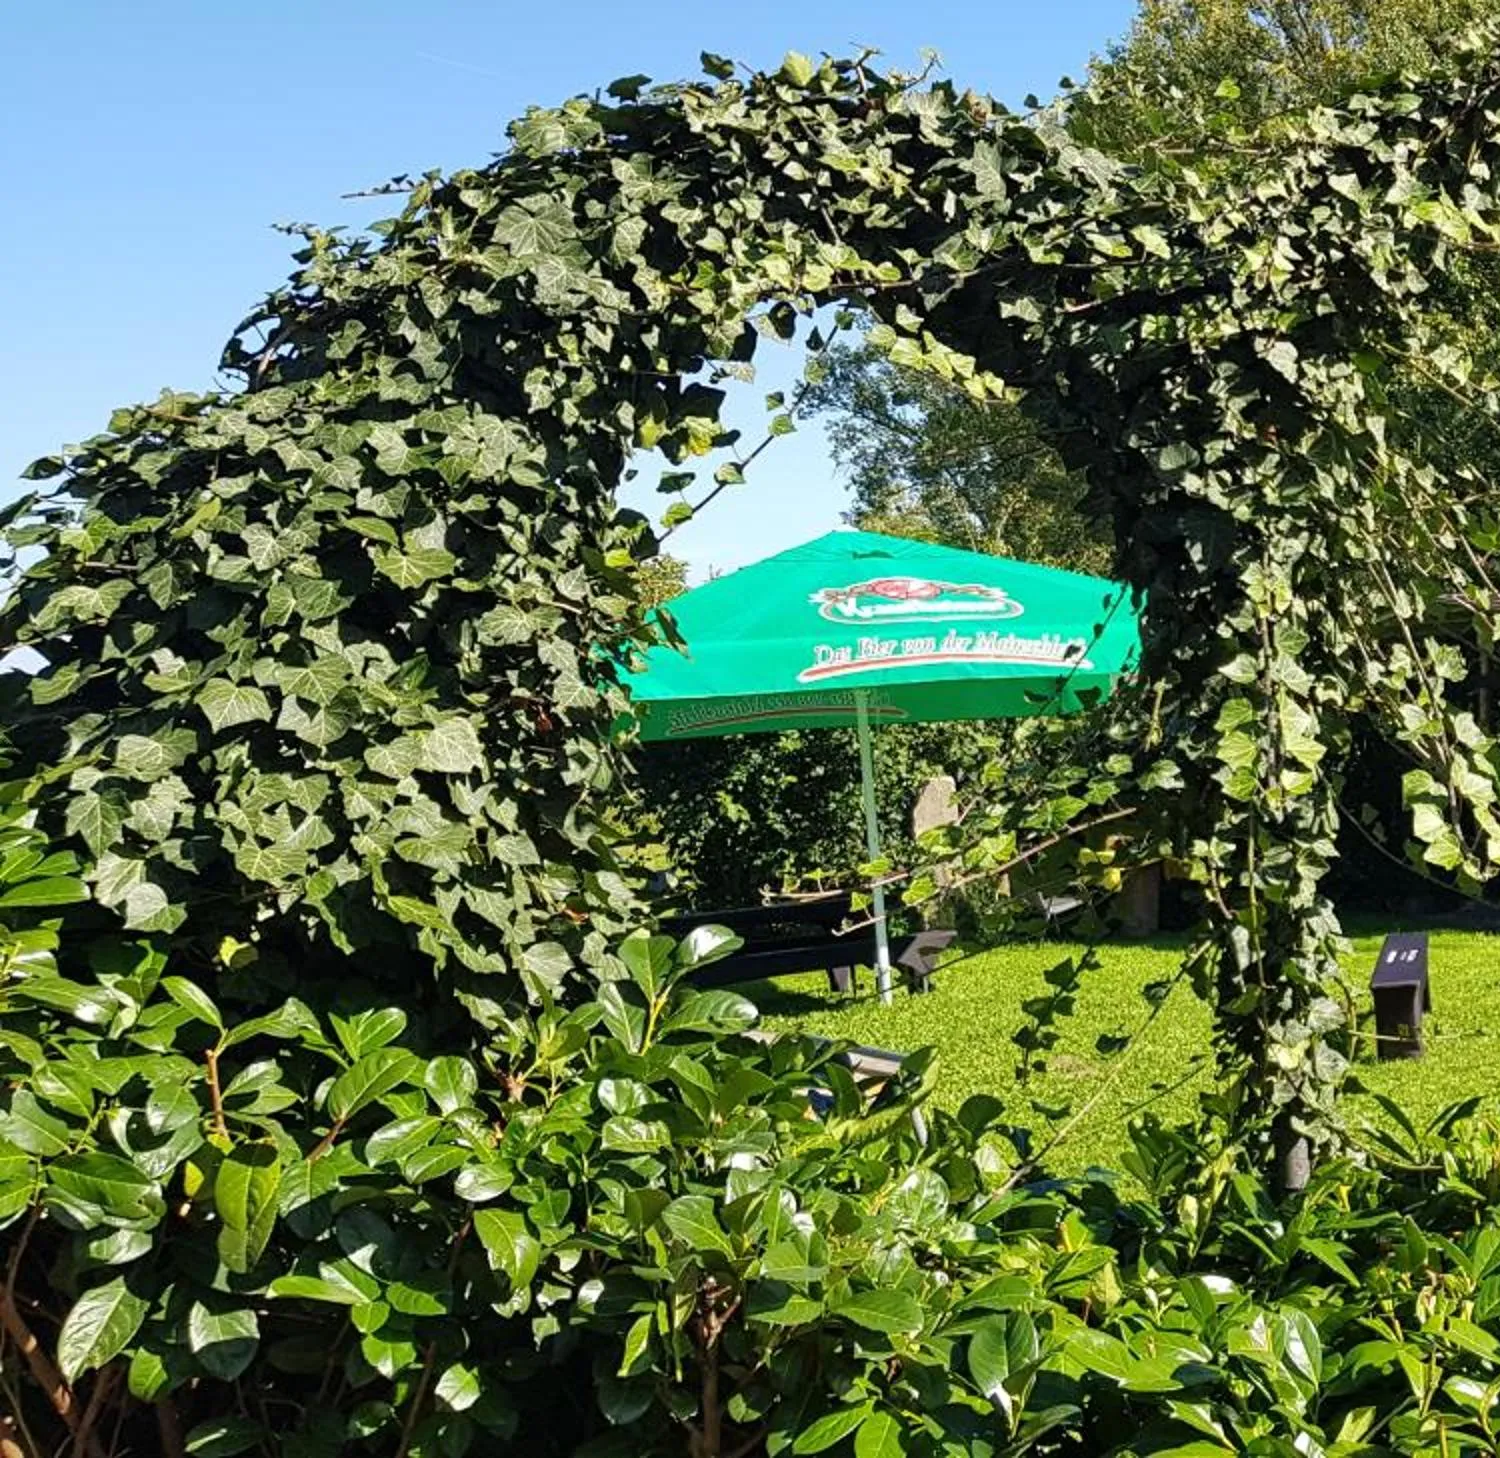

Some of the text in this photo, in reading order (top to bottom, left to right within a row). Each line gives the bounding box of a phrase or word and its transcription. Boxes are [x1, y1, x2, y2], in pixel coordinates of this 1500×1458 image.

[814, 645, 852, 666] Das
[857, 636, 897, 659] Bier
[903, 637, 936, 654] von
[942, 628, 973, 651] der
